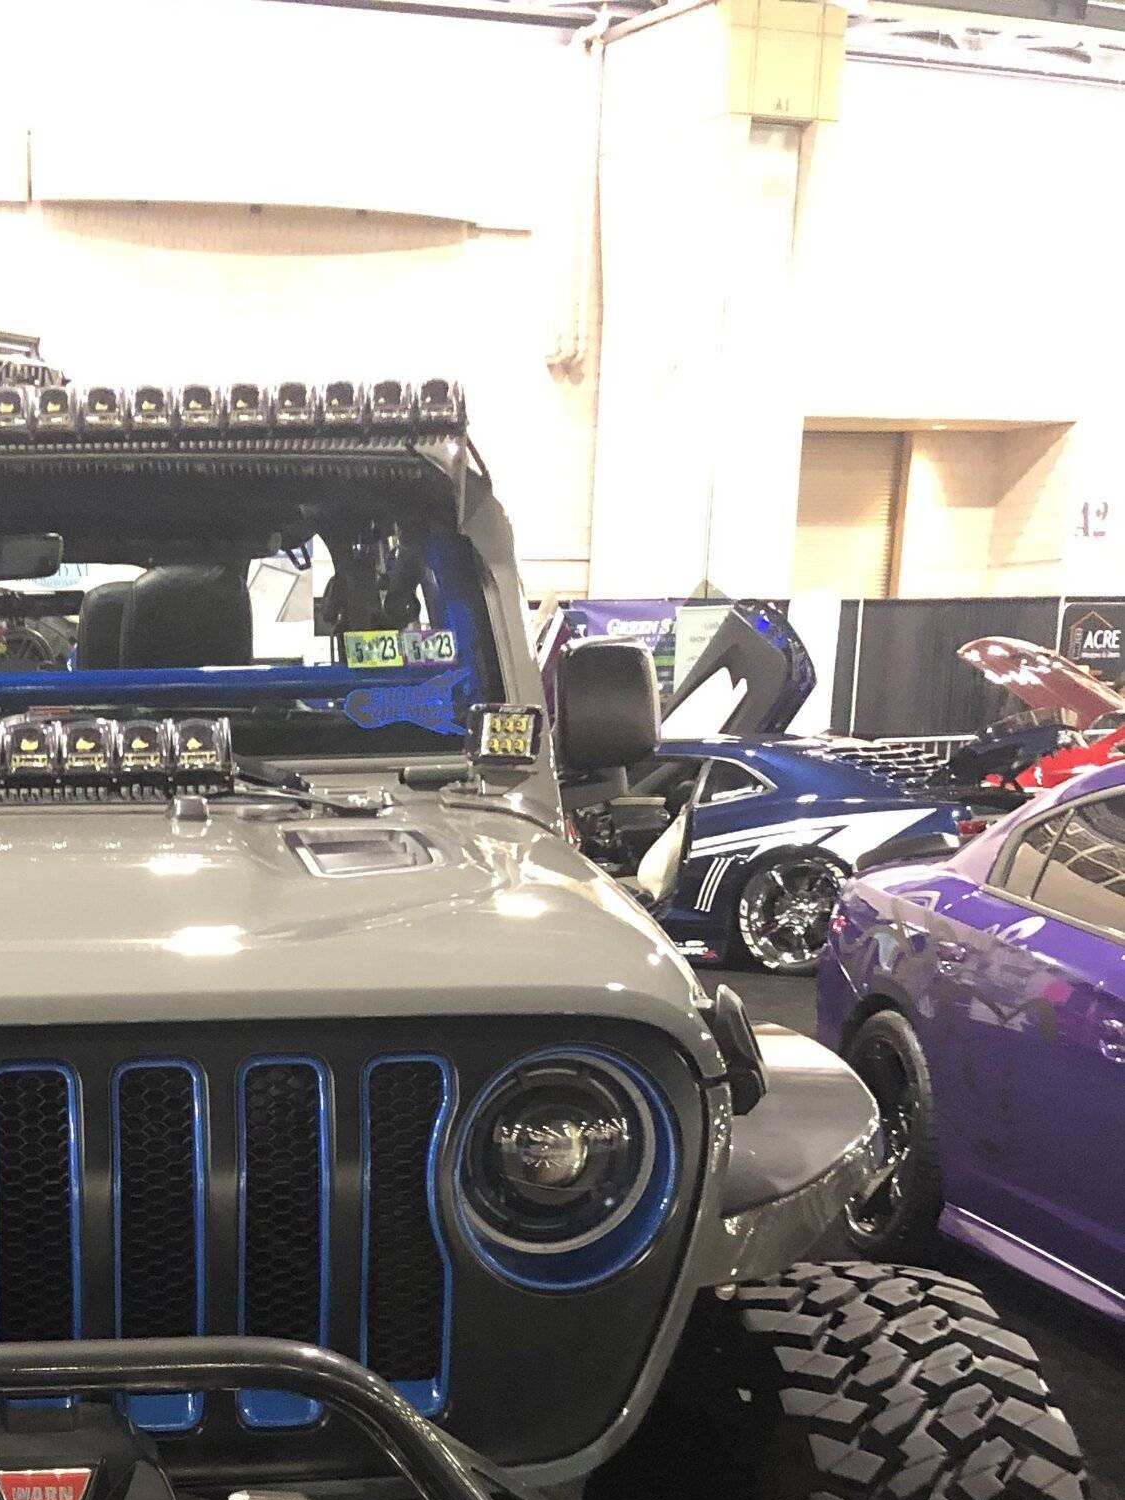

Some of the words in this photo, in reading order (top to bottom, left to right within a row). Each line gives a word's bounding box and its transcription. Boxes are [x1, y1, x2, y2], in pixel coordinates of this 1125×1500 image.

[355, 642, 364, 662] 5
[380, 636, 397, 660] 23
[412, 641, 421, 660] 5
[436, 634, 453, 658] 23
[1083, 629, 1122, 649] ACRE
